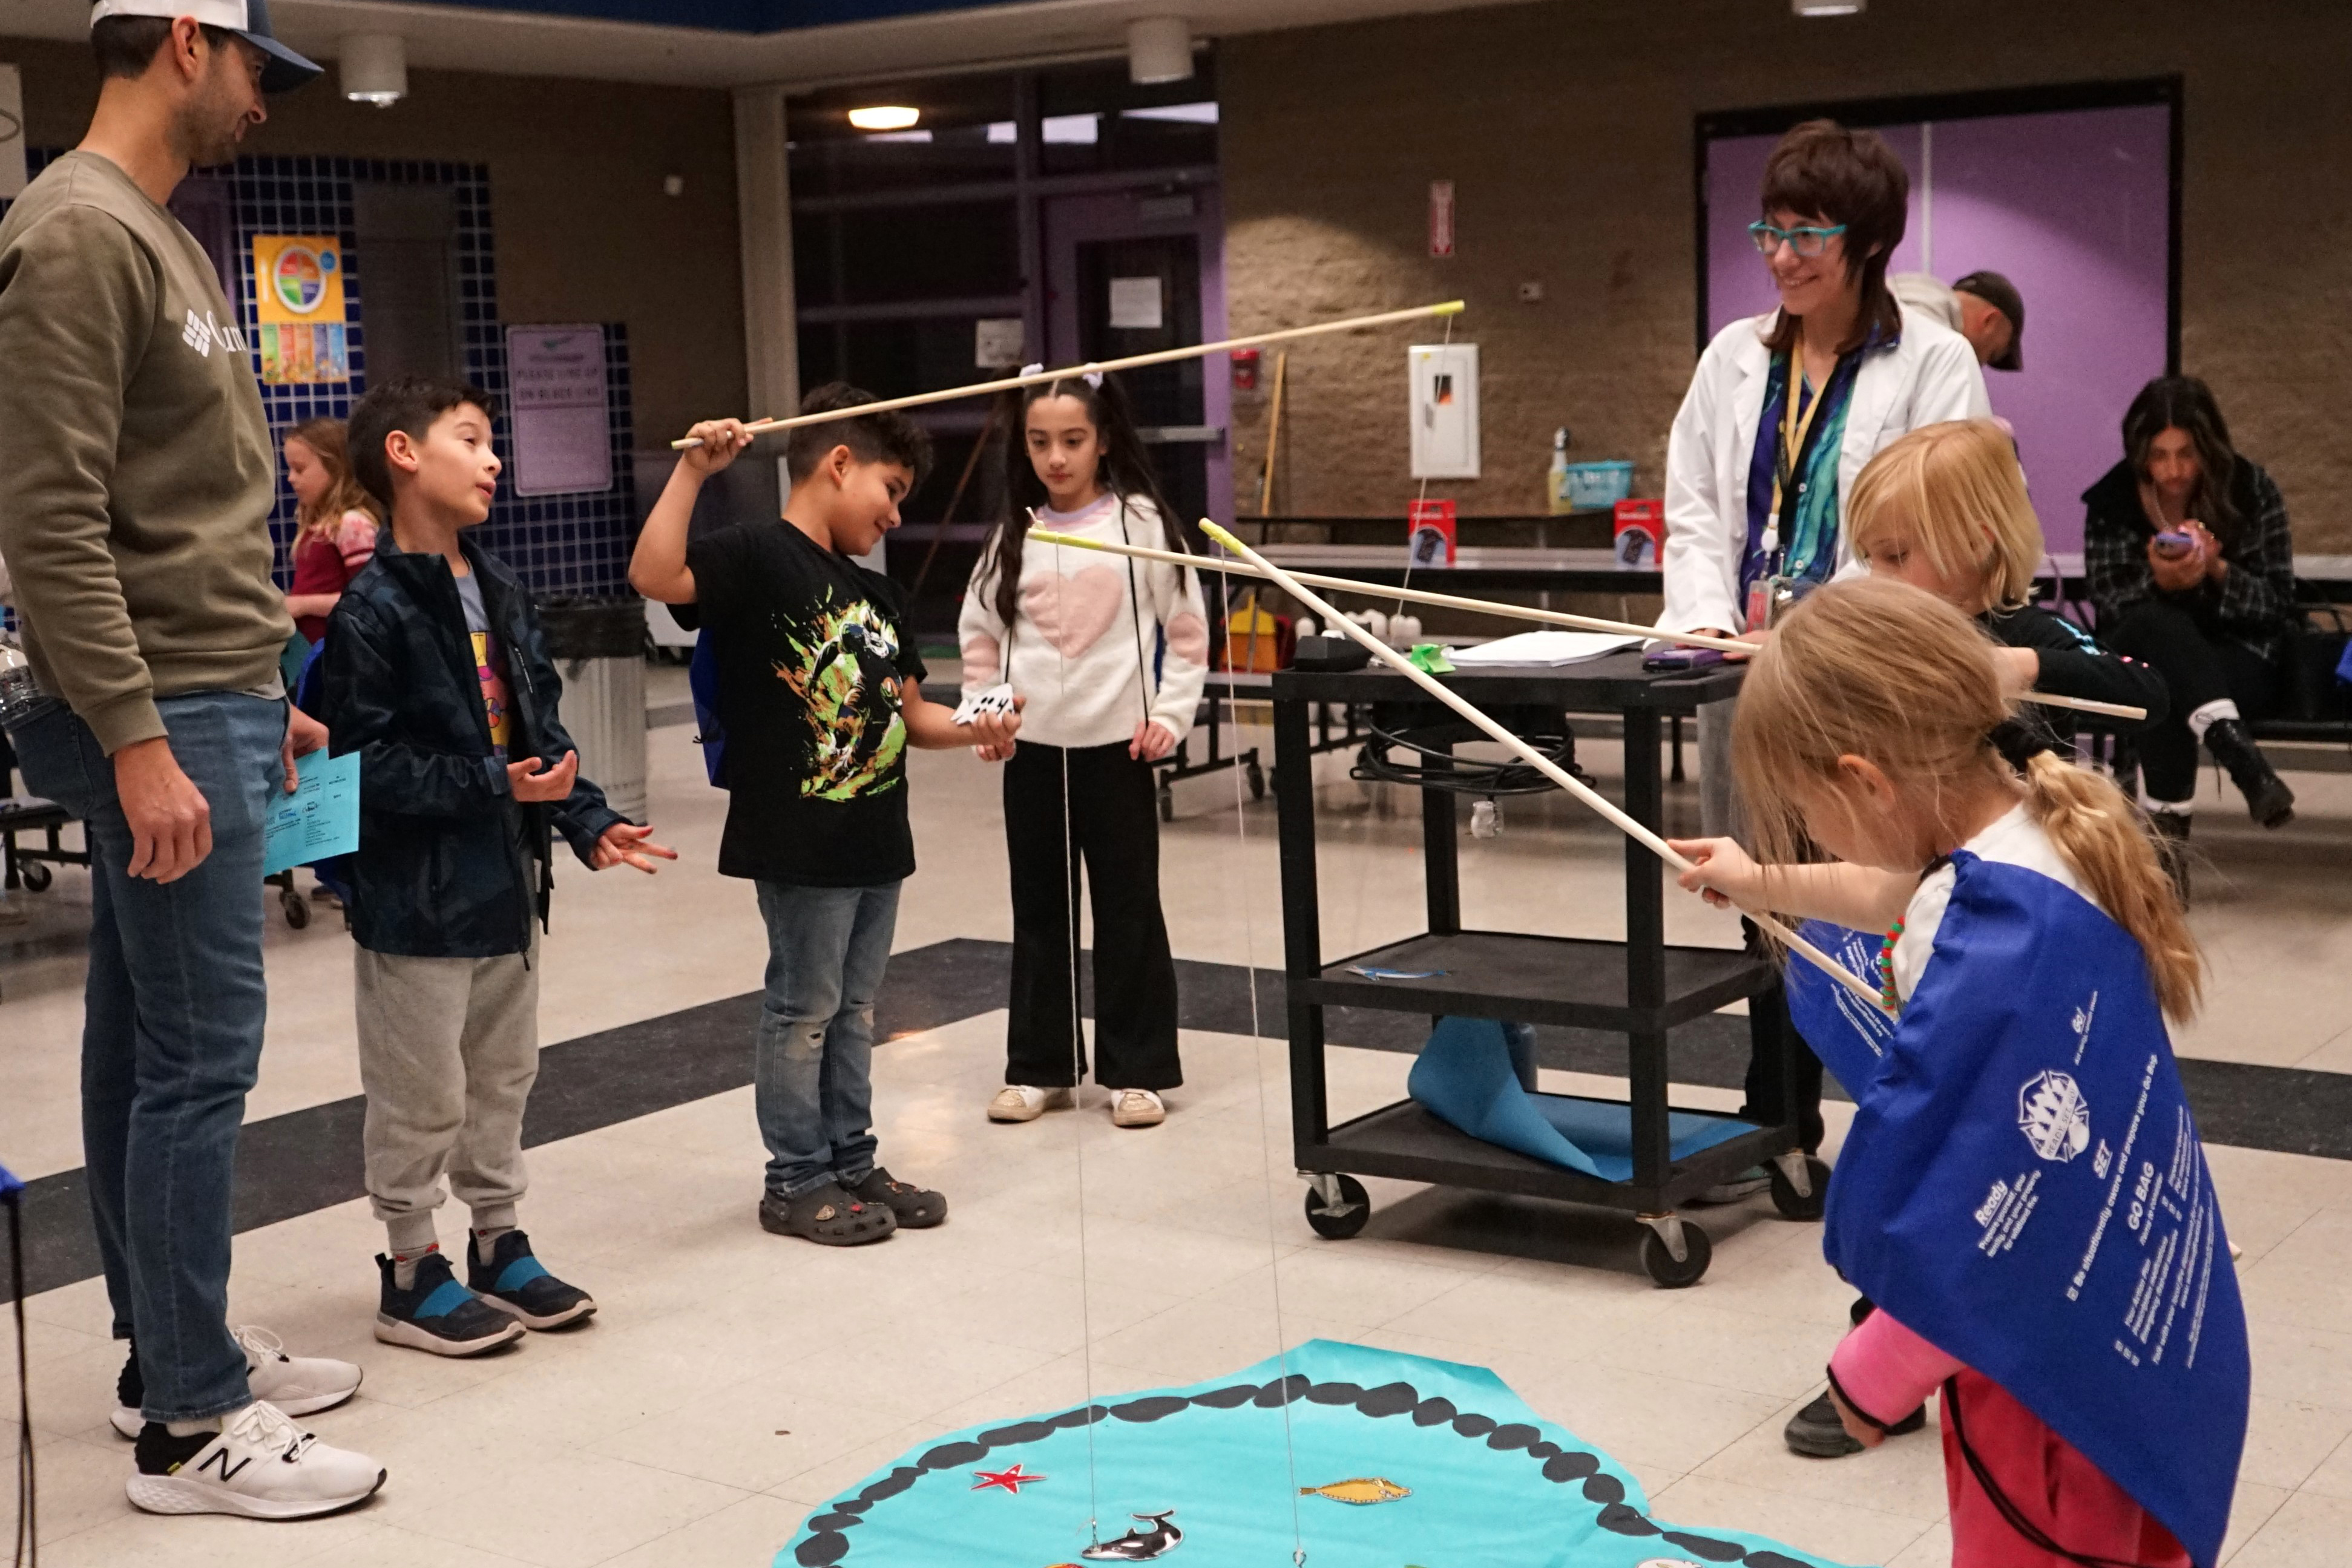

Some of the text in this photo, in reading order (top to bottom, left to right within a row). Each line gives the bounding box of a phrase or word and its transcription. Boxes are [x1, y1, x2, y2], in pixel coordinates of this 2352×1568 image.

[2074, 1271, 2085, 1287] Be
[2083, 1207, 2112, 1271] situationally
[2107, 1175, 2122, 1207] aware
[2118, 1152, 2127, 1174] and
[2124, 1115, 2140, 1154] prepare
[2137, 1091, 2147, 1115] your
[2143, 1075, 2151, 1090] Go
[2094, 1139, 2112, 1179] SET
[1974, 1179, 2008, 1227] Ready
[1979, 1221, 2000, 1250] Prepare
[2014, 1174, 2026, 1192] your
[2003, 1217, 2014, 1233] and
[2011, 1201, 2023, 1219] your
[2128, 1162, 2153, 1230] GO BAG
[2004, 1238, 2013, 1250] for
[2011, 1208, 2031, 1239] wildland
[197, 1448, 253, 1482] N
